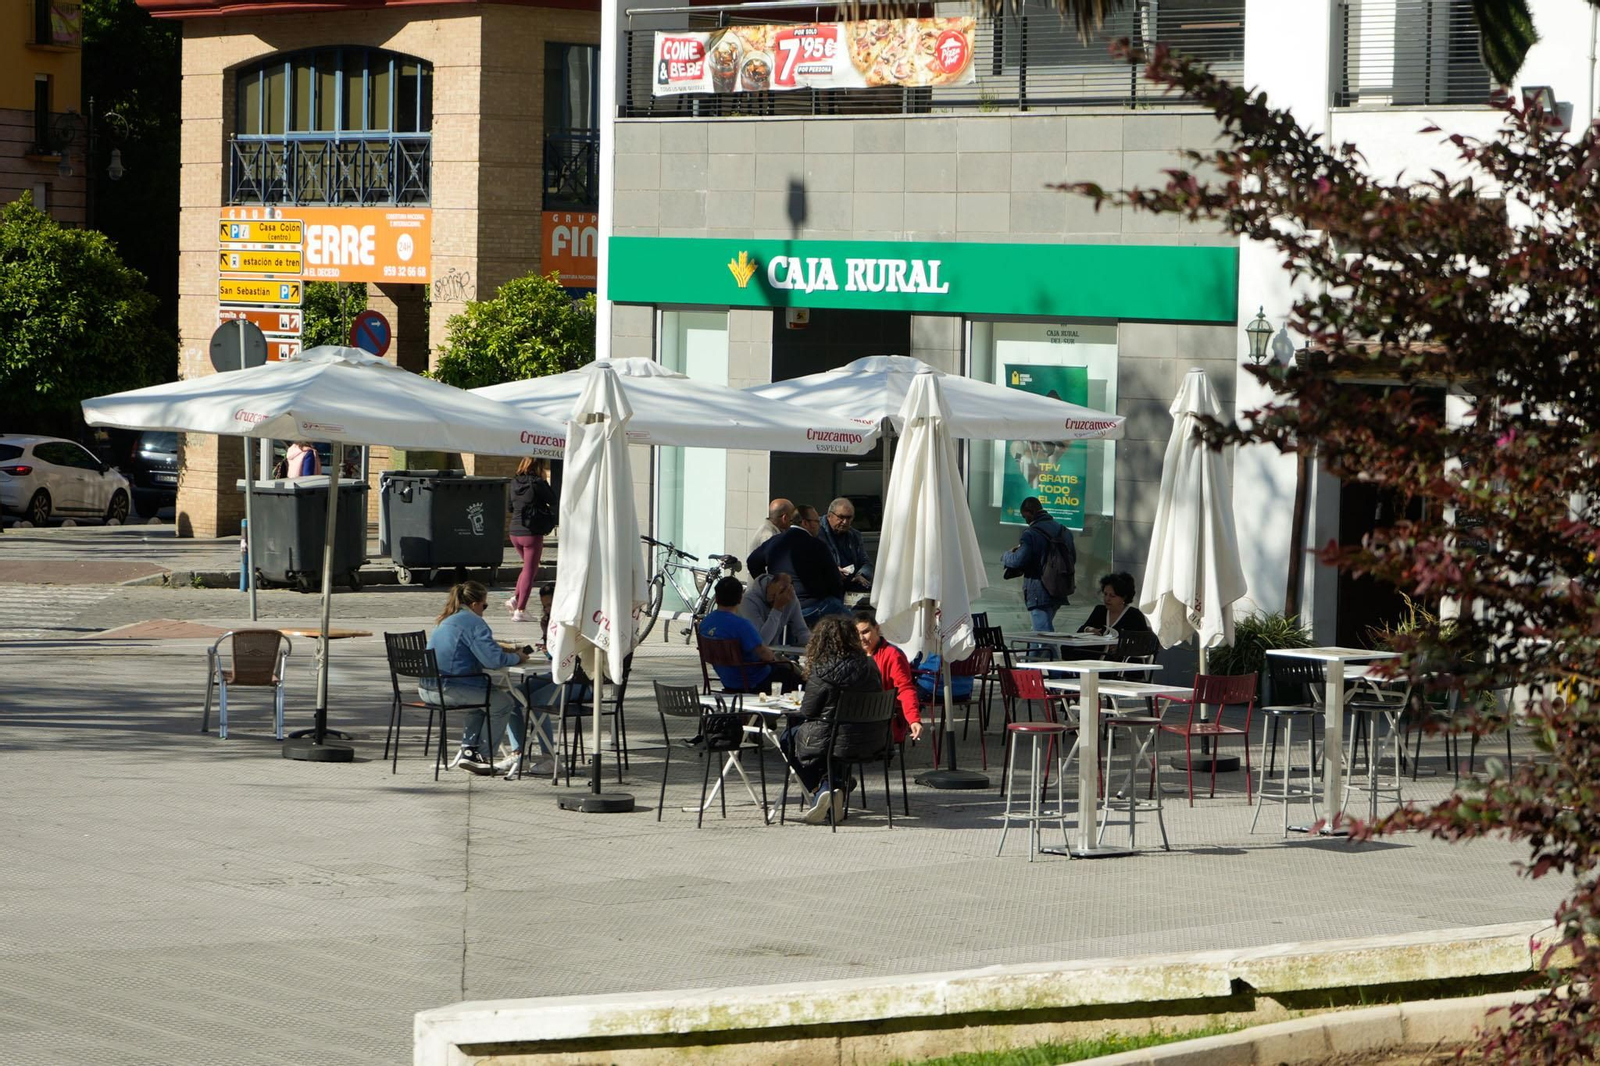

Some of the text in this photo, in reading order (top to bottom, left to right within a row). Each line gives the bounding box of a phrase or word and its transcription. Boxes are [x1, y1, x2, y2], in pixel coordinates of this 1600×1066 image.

[663, 40, 700, 60] COME
[660, 62, 702, 80] & BEBE
[259, 222, 276, 232] Casa
[280, 222, 300, 232] Colón
[304, 224, 376, 266] ERRE
[244, 256, 300, 266] estación de tren
[768, 256, 950, 294] CAJA RURAL
[220, 286, 232, 294] San
[806, 428, 862, 444] Cruzcampo
[816, 444, 848, 452] ESPECIAL
[1038, 462, 1061, 472] TPV
[1038, 474, 1078, 484] GRATIS
[1038, 484, 1070, 494] TODO
[1038, 494, 1080, 506] EL AÑO
